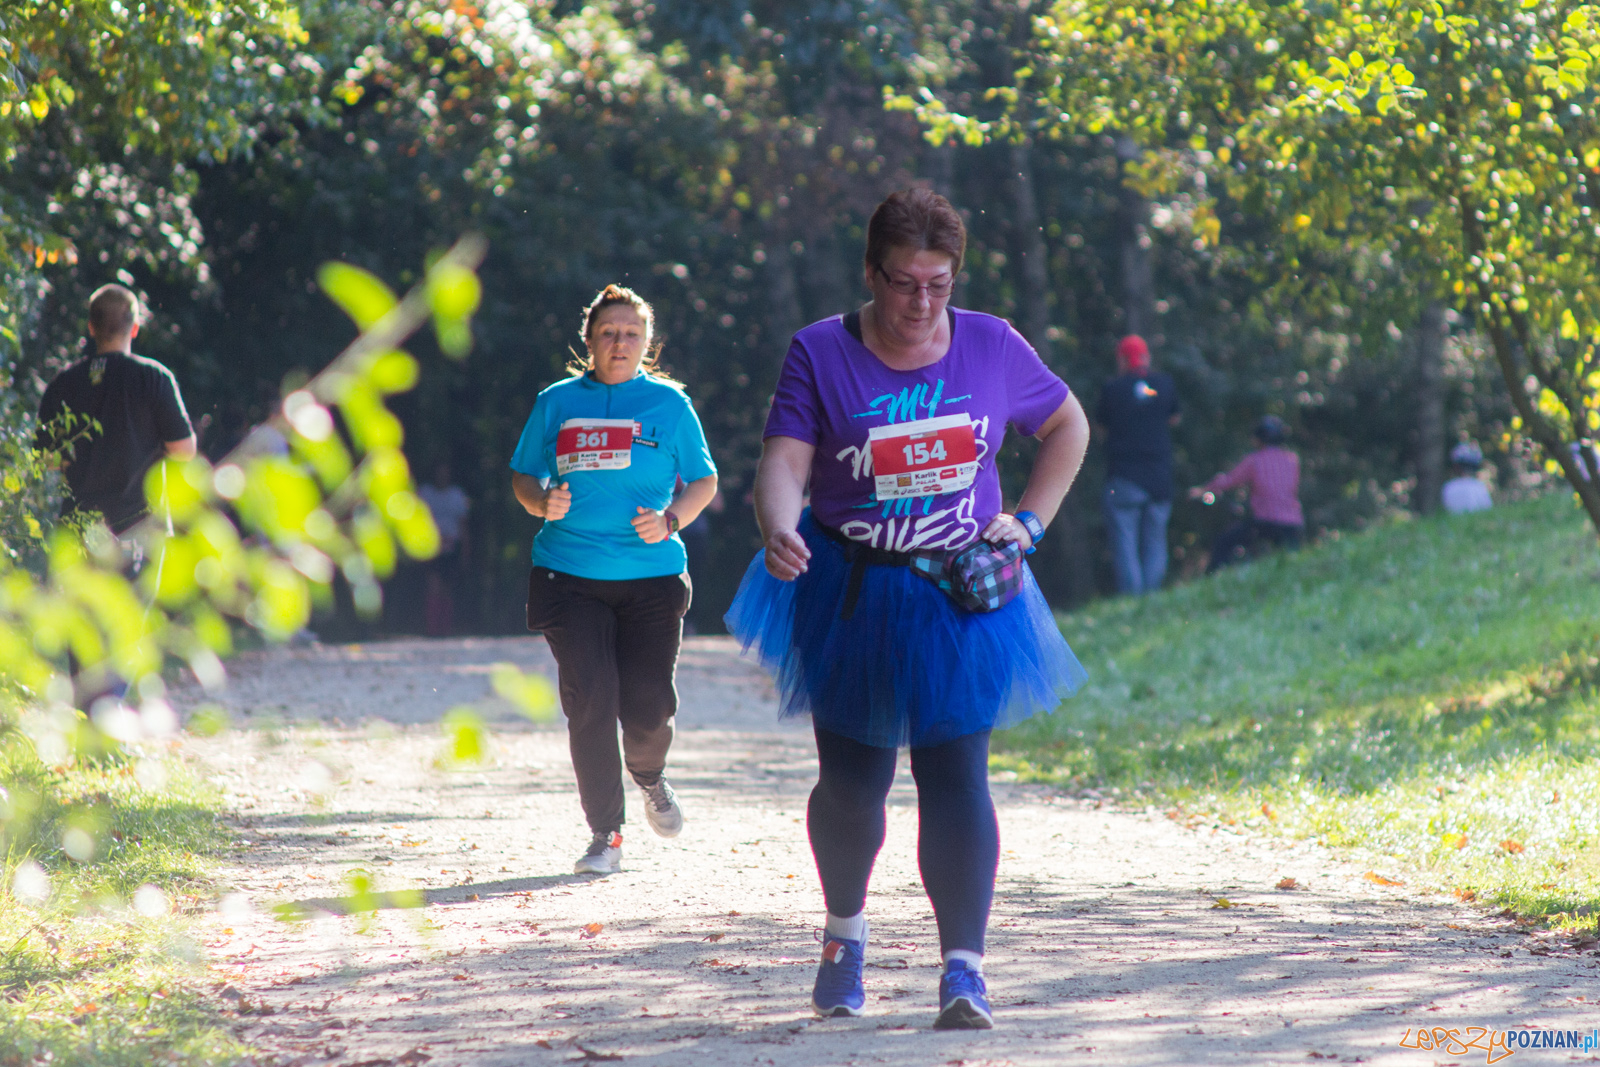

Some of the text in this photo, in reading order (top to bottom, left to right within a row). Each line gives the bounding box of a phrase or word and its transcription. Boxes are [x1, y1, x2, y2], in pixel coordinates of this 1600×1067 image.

[869, 379, 945, 424] MY
[575, 432, 608, 448] 361
[902, 439, 948, 466] 154
[914, 471, 938, 480] Karlik
